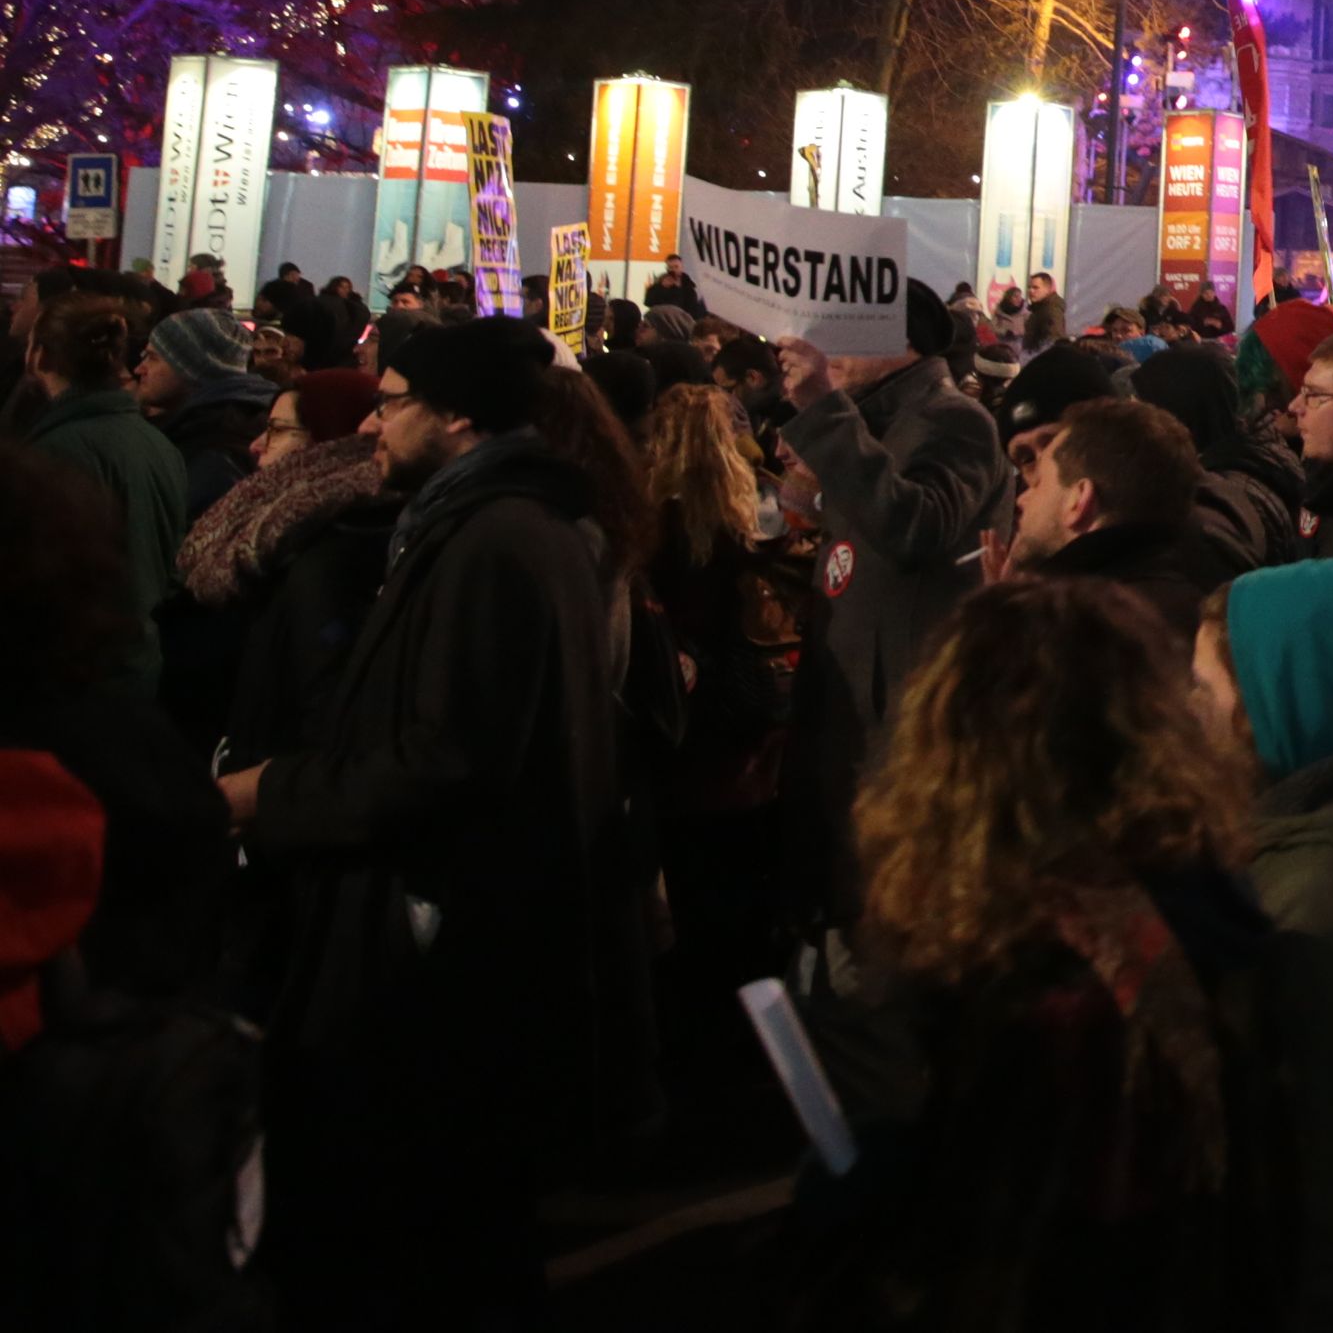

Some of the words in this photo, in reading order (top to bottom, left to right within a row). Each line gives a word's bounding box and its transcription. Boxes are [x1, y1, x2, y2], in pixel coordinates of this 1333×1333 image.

[1169, 165, 1204, 181] WIEN
[1168, 182, 1204, 197] HEUTE
[1166, 235, 1191, 250] ORF
[1193, 235, 1201, 250] 2
[688, 217, 899, 305] WIDERSTAND
